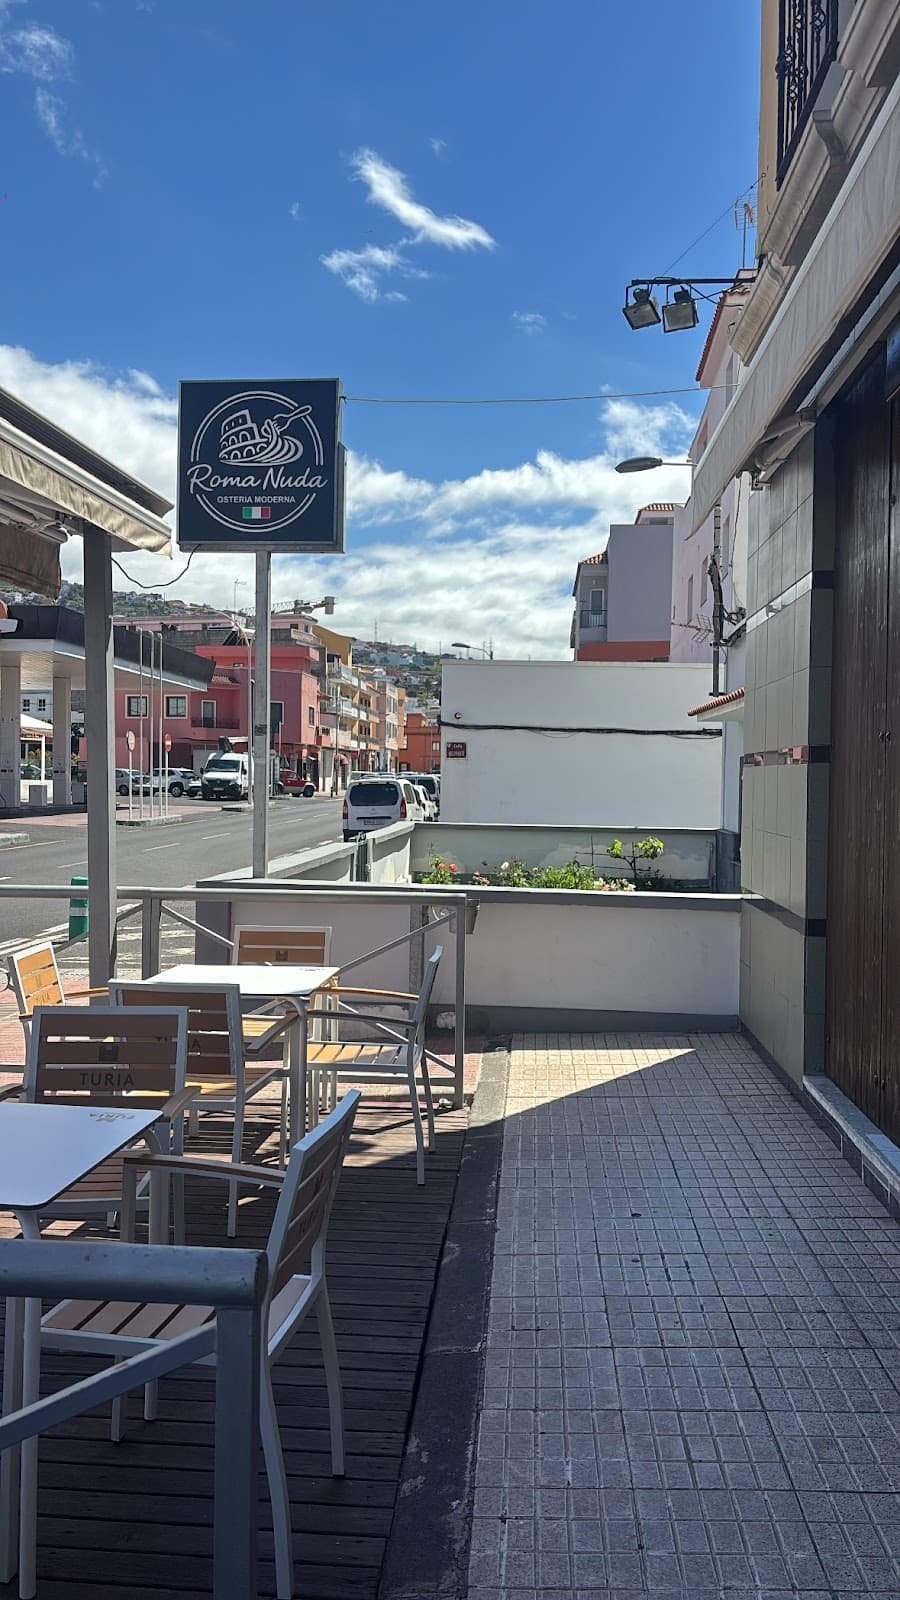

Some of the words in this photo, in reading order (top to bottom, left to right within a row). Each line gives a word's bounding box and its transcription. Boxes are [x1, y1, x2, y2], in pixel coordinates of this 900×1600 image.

[186, 463, 261, 494] Roma
[262, 466, 328, 490] Nuda
[216, 495, 253, 503] OSTERIA
[254, 495, 296, 503] MODERNA
[79, 1072, 135, 1087] TURIA
